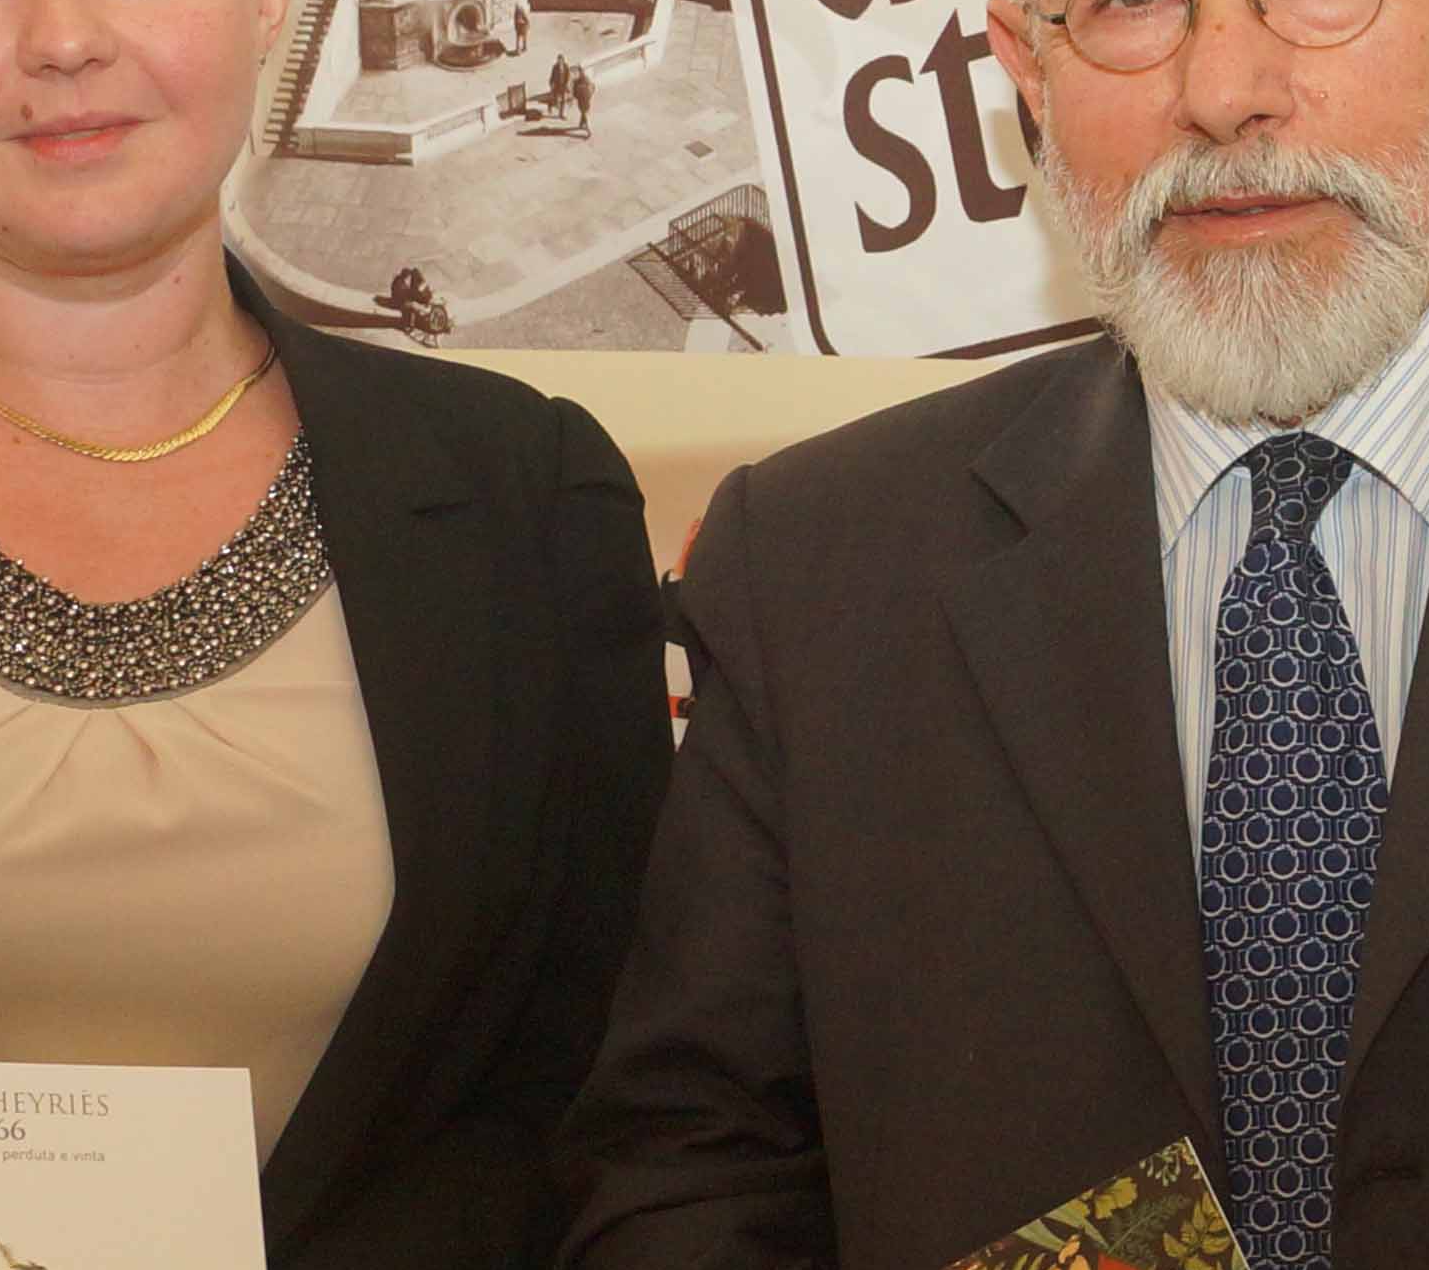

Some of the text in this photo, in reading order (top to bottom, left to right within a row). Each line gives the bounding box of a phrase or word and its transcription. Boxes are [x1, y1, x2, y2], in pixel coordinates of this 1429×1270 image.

[2, 1148, 56, 1163] perduta
[60, 1152, 68, 1161] e
[73, 1150, 106, 1162] vinta
